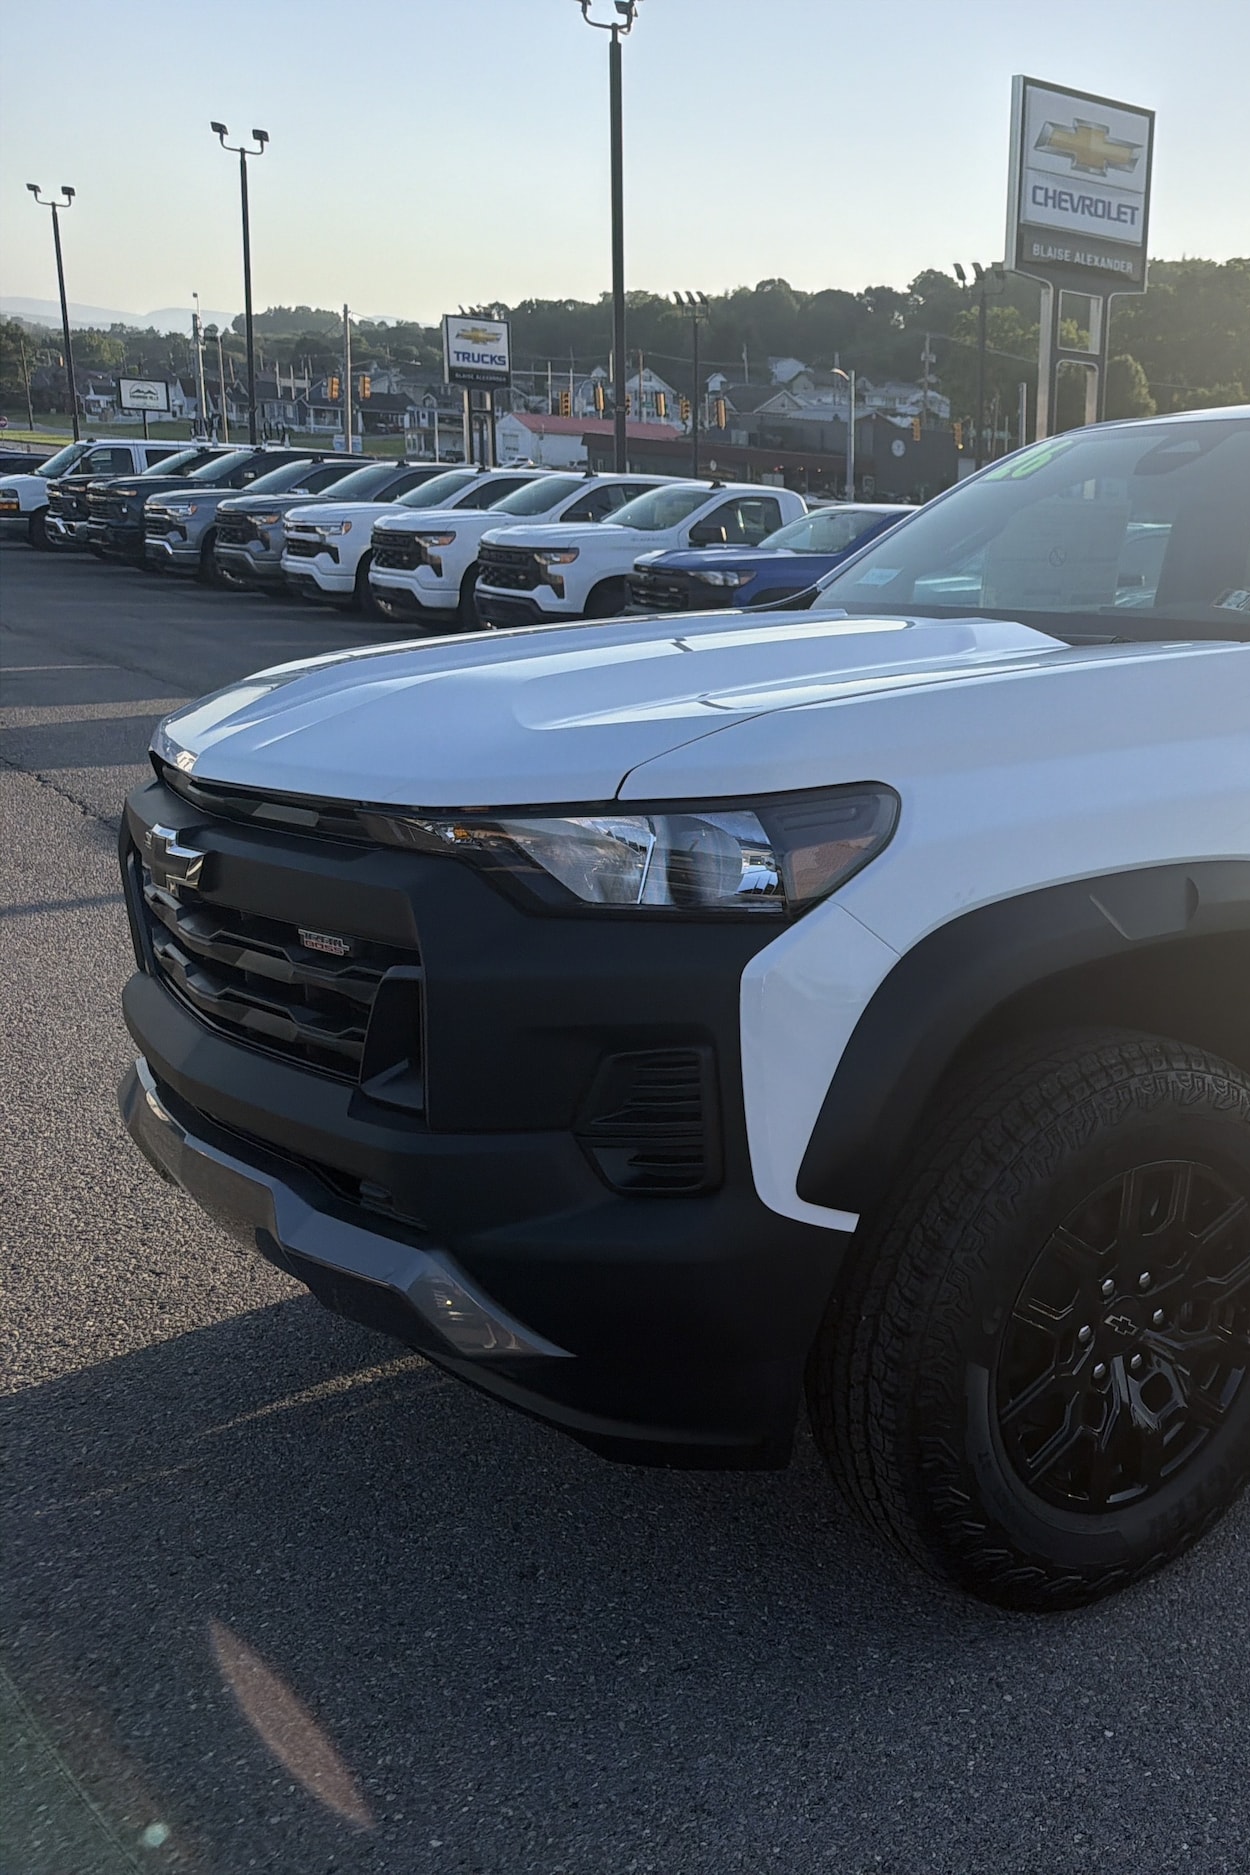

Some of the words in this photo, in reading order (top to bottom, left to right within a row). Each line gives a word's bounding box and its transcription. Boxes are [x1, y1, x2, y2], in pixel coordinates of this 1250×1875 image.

[1032, 185, 1139, 225] CHEVROLET
[1032, 244, 1071, 260] BLAISE
[1074, 251, 1133, 273] ALEXANDER
[453, 350, 506, 366] TRUCKS
[304, 939, 344, 956] BOSS
